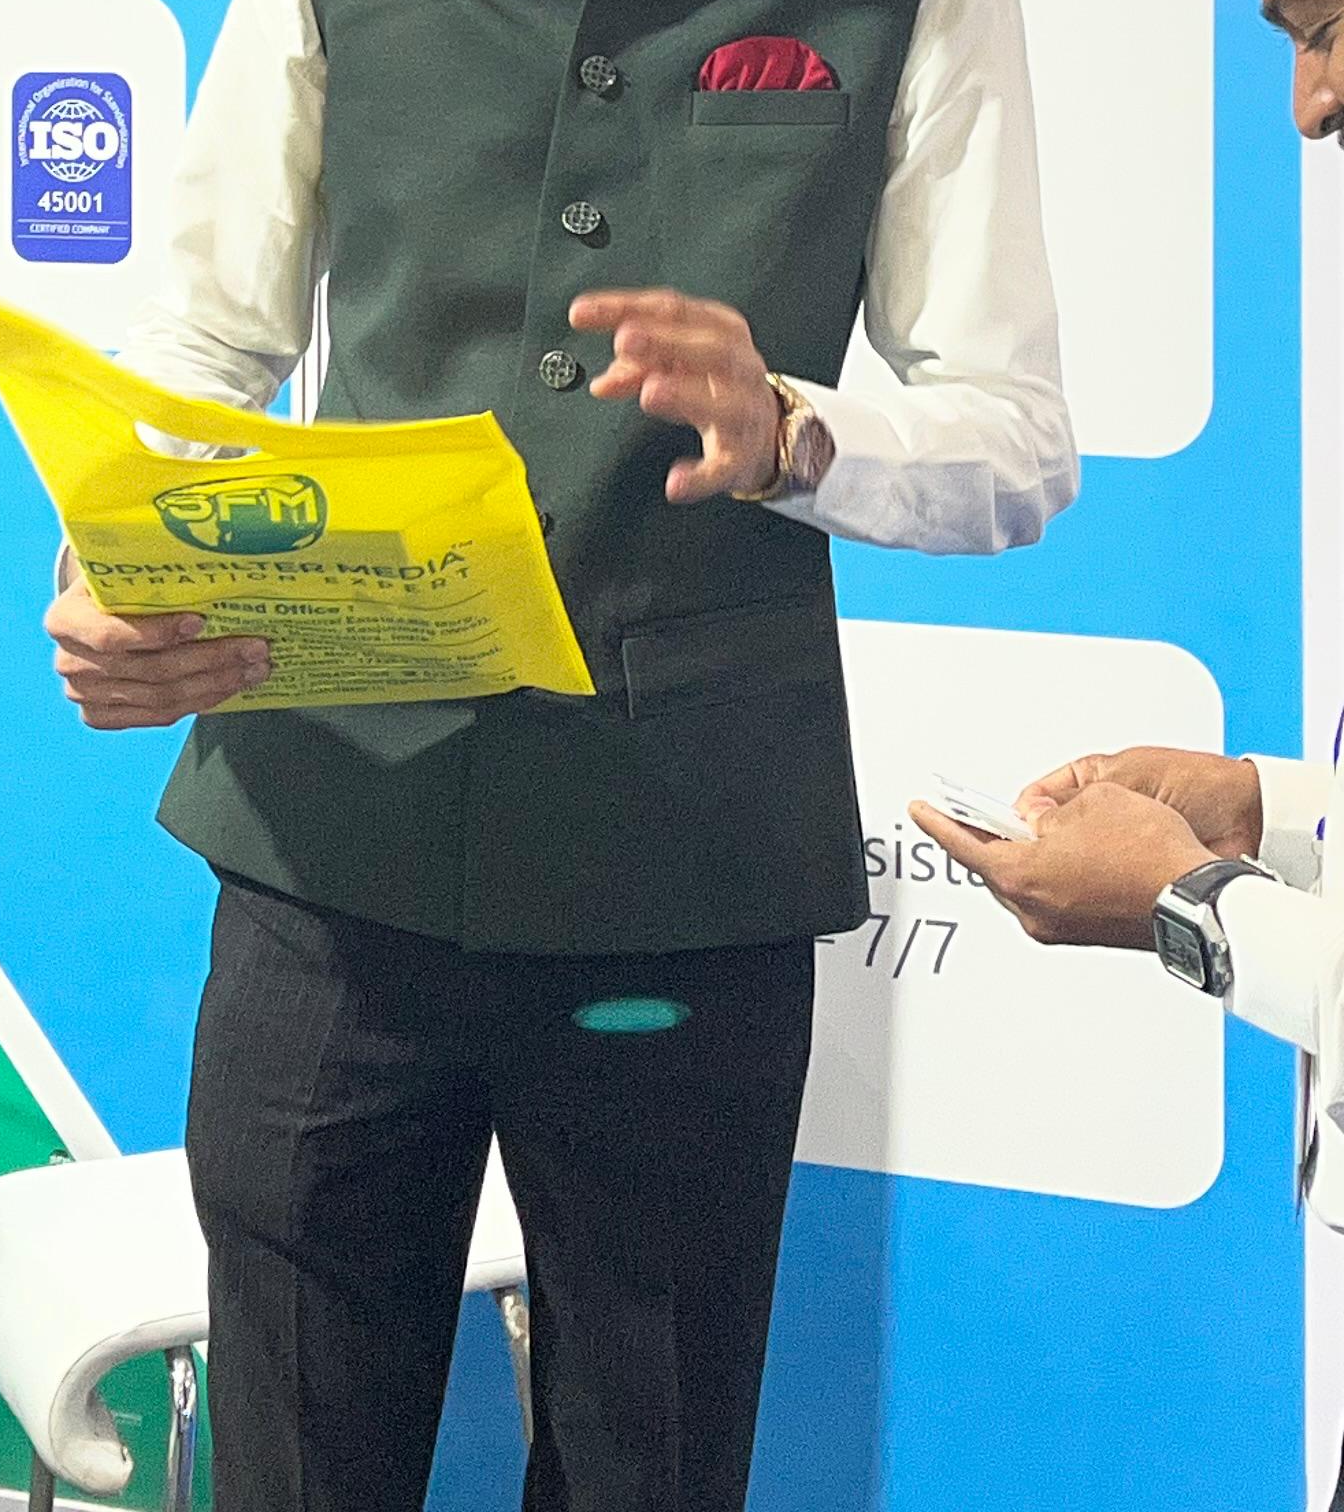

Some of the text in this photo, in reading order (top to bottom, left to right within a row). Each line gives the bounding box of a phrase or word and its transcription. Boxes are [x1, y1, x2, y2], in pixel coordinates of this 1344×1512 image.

[32, 77, 90, 104] Organization
[89, 81, 104, 96] for
[28, 120, 121, 161] ISO
[37, 190, 104, 214] 45001
[166, 488, 318, 524] SFM
[84, 560, 187, 576] DDHI
[337, 551, 465, 580] MEDIA
[99, 571, 296, 588] LTRATION
[274, 603, 341, 616] Office
